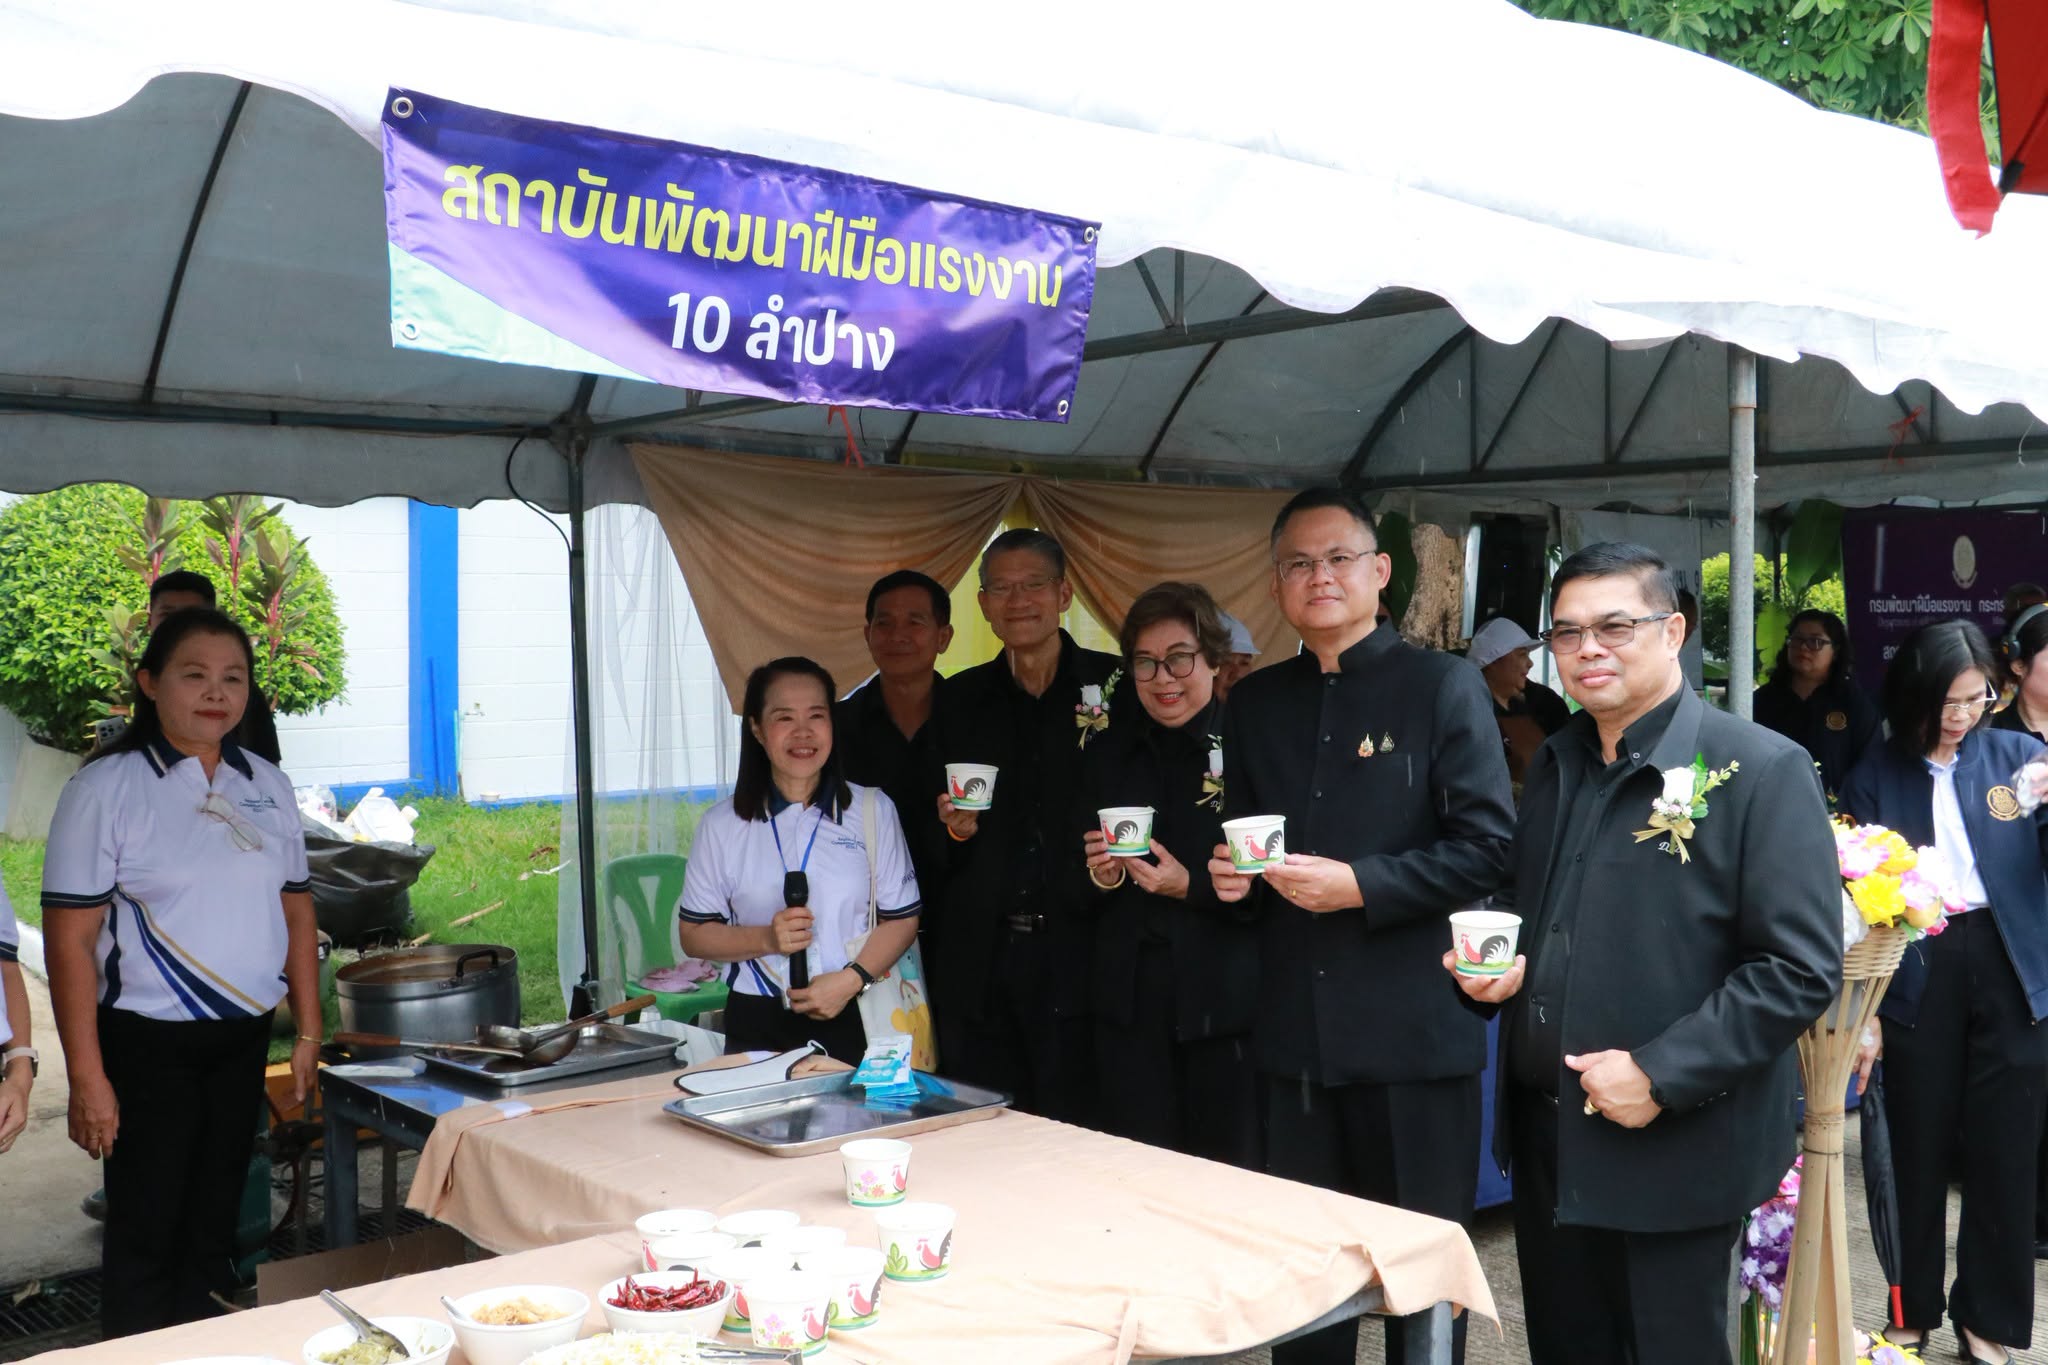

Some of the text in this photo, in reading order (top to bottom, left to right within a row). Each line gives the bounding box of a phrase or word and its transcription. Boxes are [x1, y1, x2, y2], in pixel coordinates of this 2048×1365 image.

[441, 164, 1063, 308] สถาบันพัฒนาฝีมือแรงงาน
[667, 292, 896, 372] 10 ลำปาง
